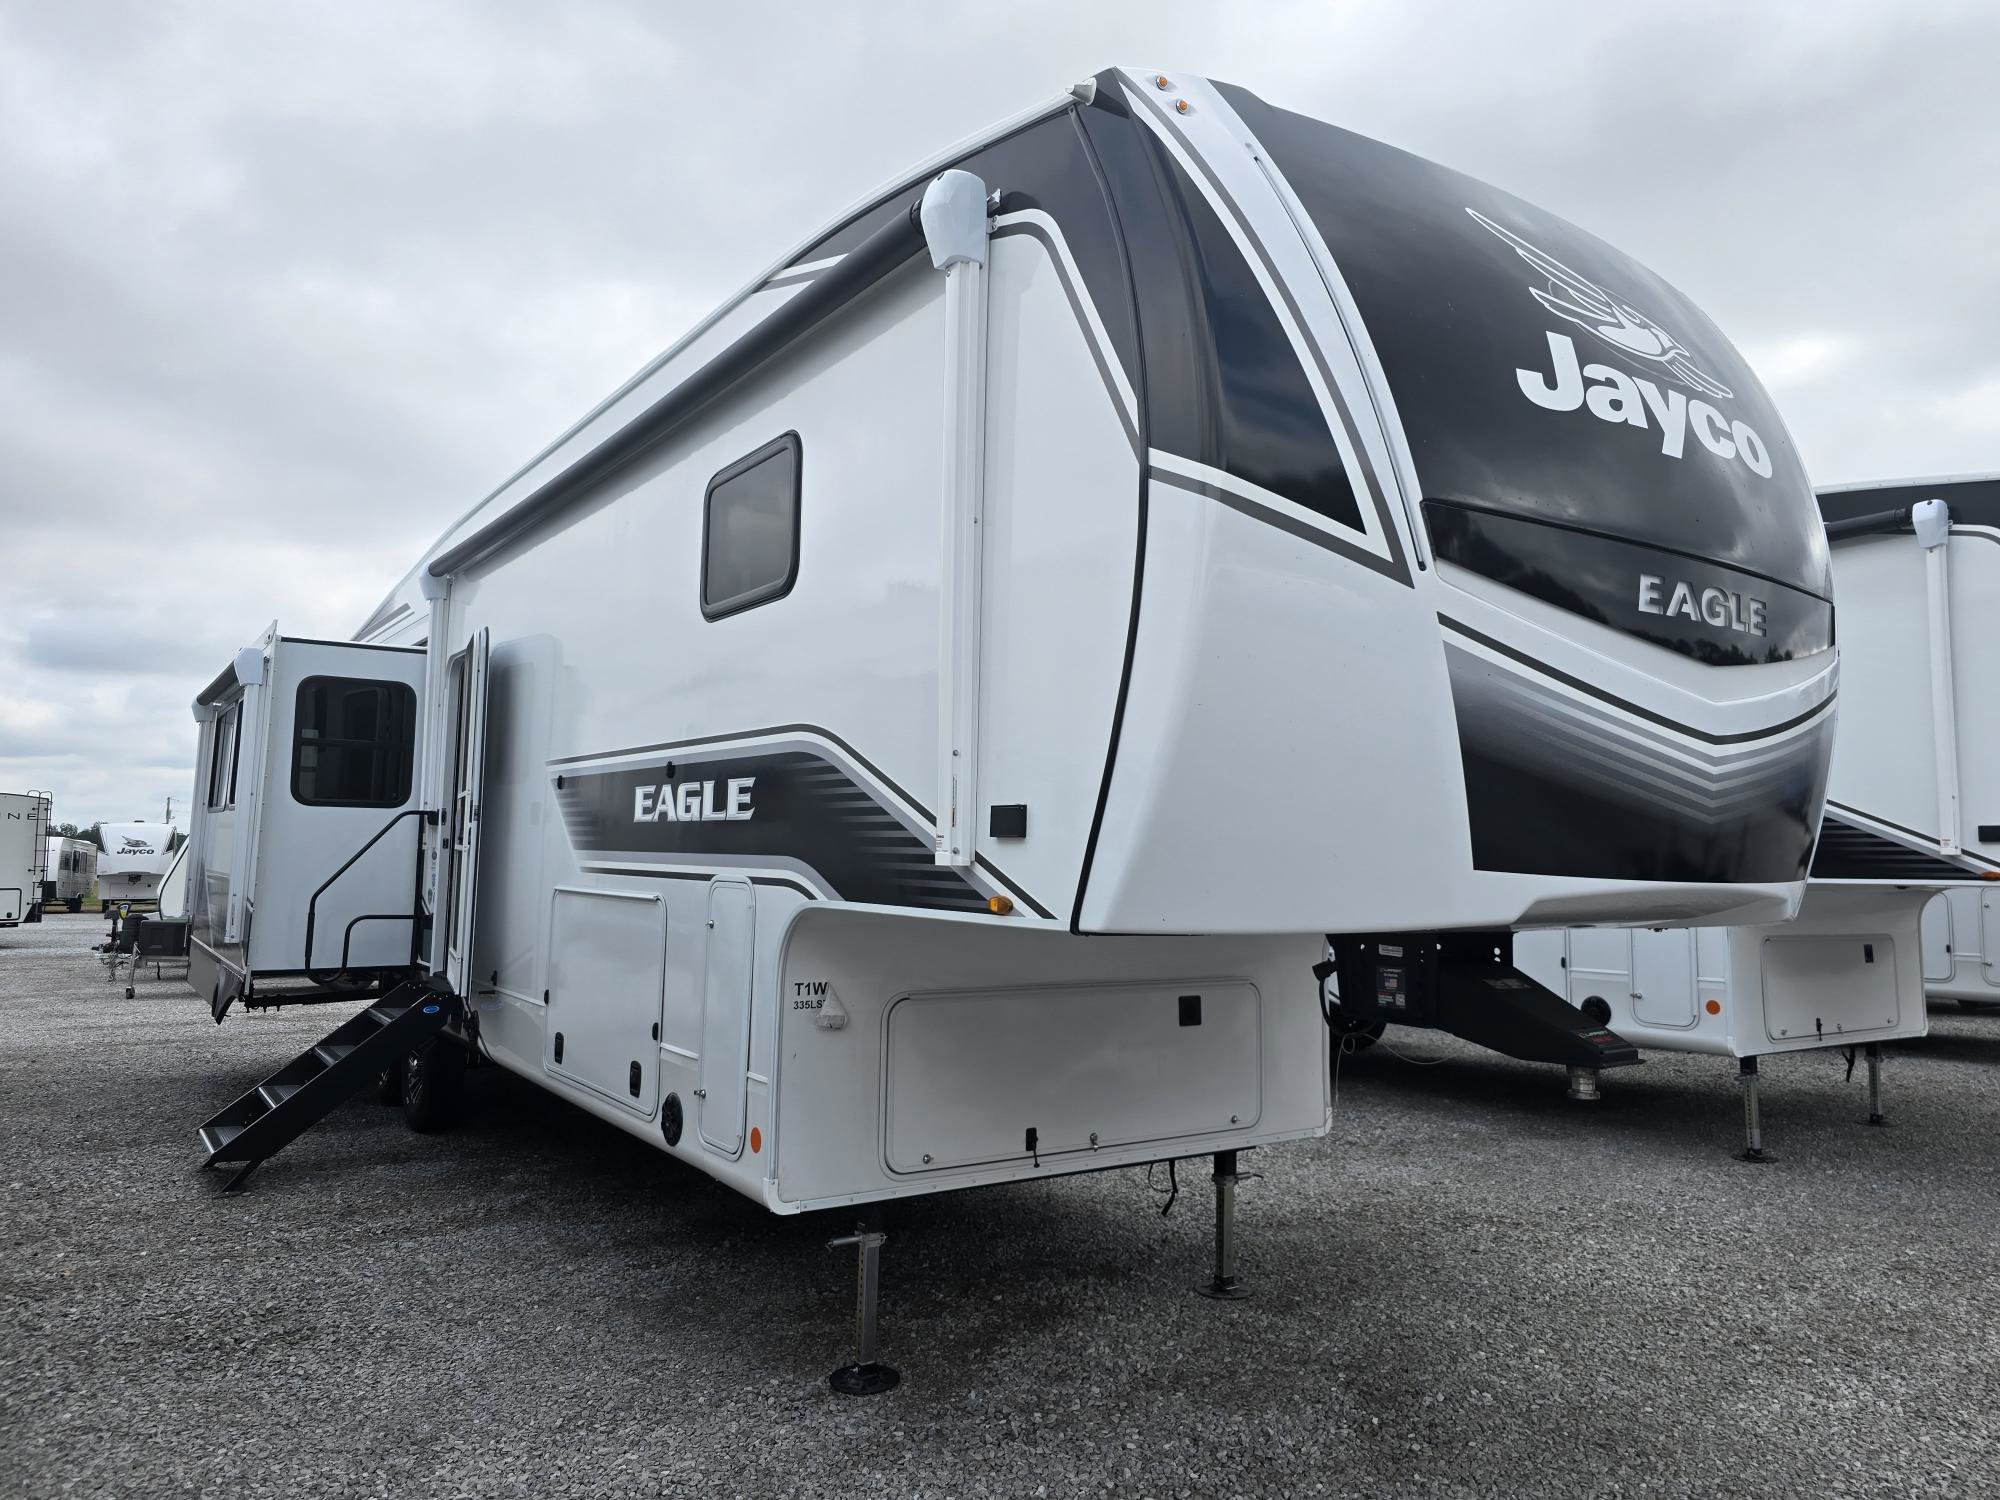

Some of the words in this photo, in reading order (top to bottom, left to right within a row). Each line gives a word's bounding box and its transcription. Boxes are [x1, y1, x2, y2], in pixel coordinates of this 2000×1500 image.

[1516, 330, 1773, 479] Jayco
[1638, 573, 1768, 638] EAGLE
[633, 776, 756, 823] EAGLE
[0, 812, 38, 820] NE
[116, 847, 155, 856] Jayco
[794, 981, 828, 997] T1W
